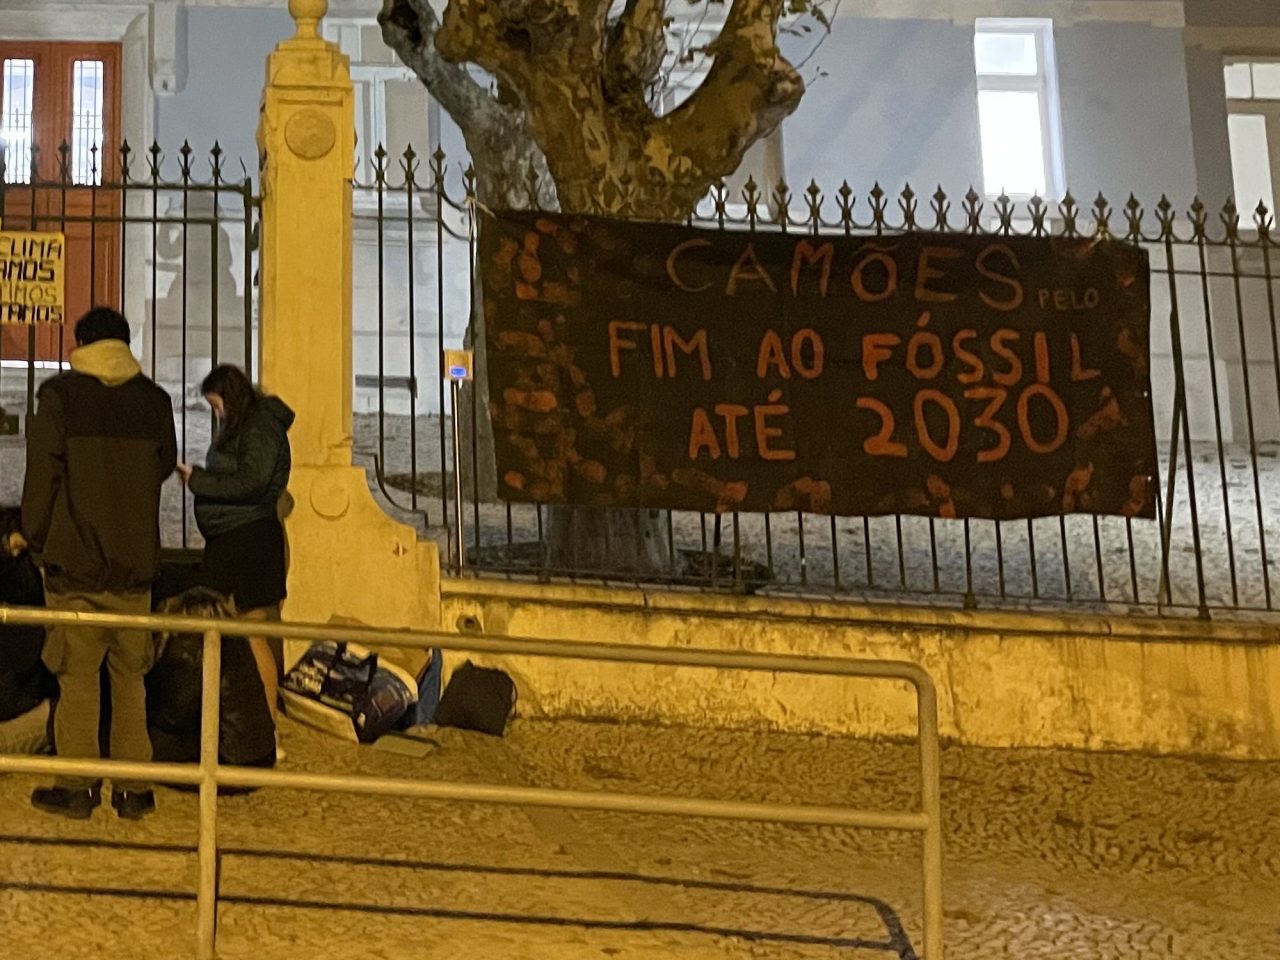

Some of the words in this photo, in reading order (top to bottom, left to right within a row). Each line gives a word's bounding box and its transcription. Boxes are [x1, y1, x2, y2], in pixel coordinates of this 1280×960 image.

[666, 239, 1023, 310] CAMÕES
[1038, 288, 1099, 309] PELO
[608, 319, 713, 380] FIM
[756, 328, 825, 380] AO
[862, 311, 1101, 385] FÓSSIL
[688, 389, 796, 460] ATÉ
[855, 384, 1070, 463] 2030
